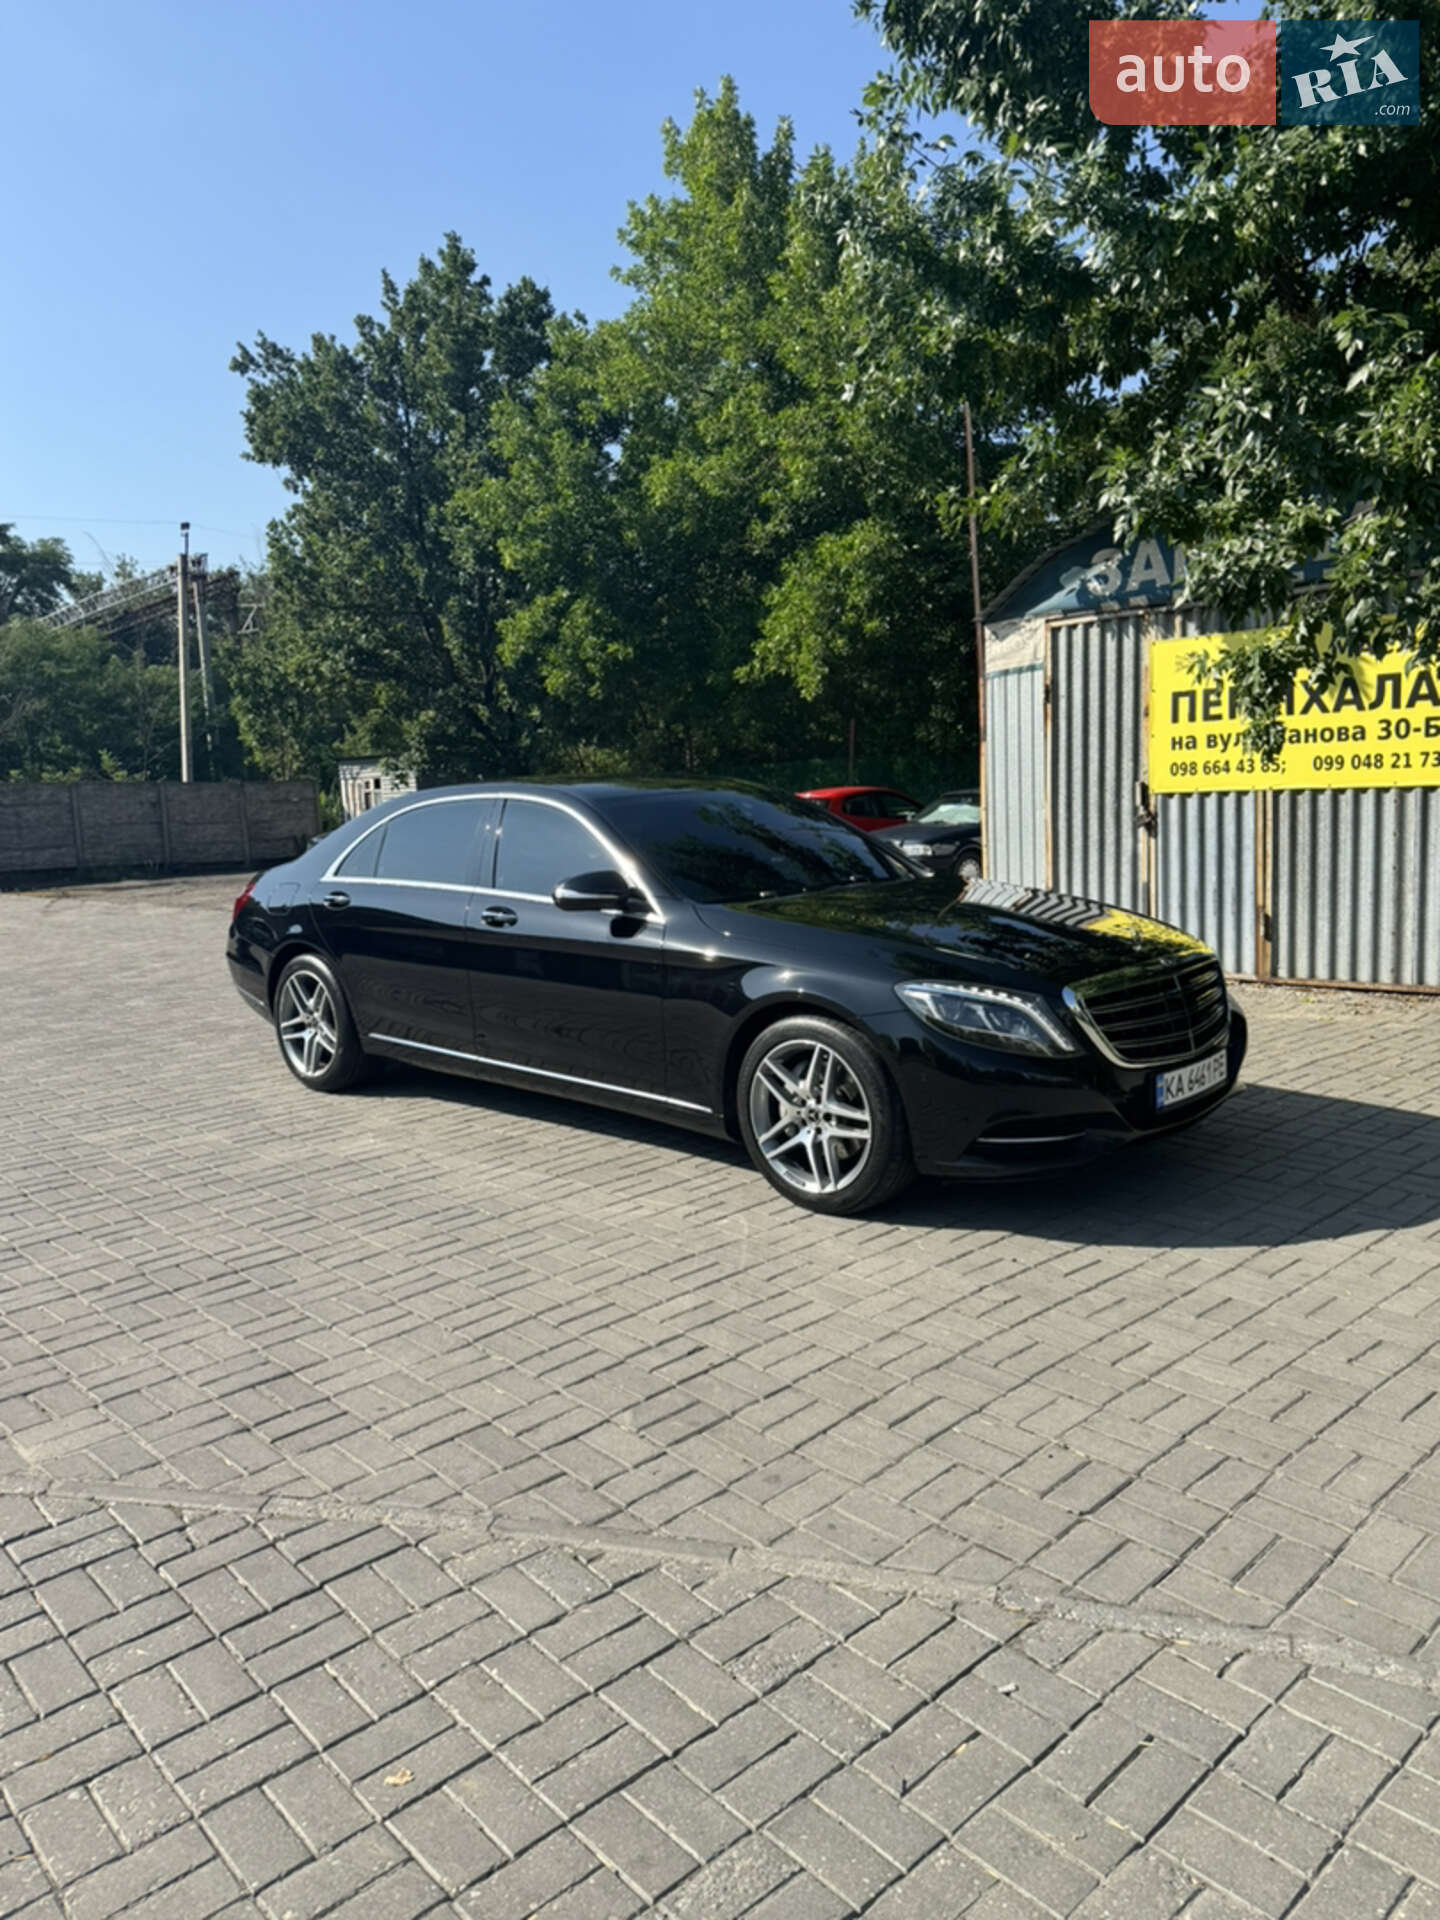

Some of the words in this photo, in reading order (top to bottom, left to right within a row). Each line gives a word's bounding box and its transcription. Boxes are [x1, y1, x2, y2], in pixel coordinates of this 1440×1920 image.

[1171, 735, 1197, 751] на
[1377, 715, 1440, 741] 30-Б
[1170, 761, 1198, 776] 098
[1202, 759, 1231, 775] 664
[1236, 758, 1255, 773] 43
[1313, 754, 1345, 771] 099
[1350, 752, 1384, 770] 048
[1390, 752, 1413, 769] 21
[1420, 750, 1440, 767] 73
